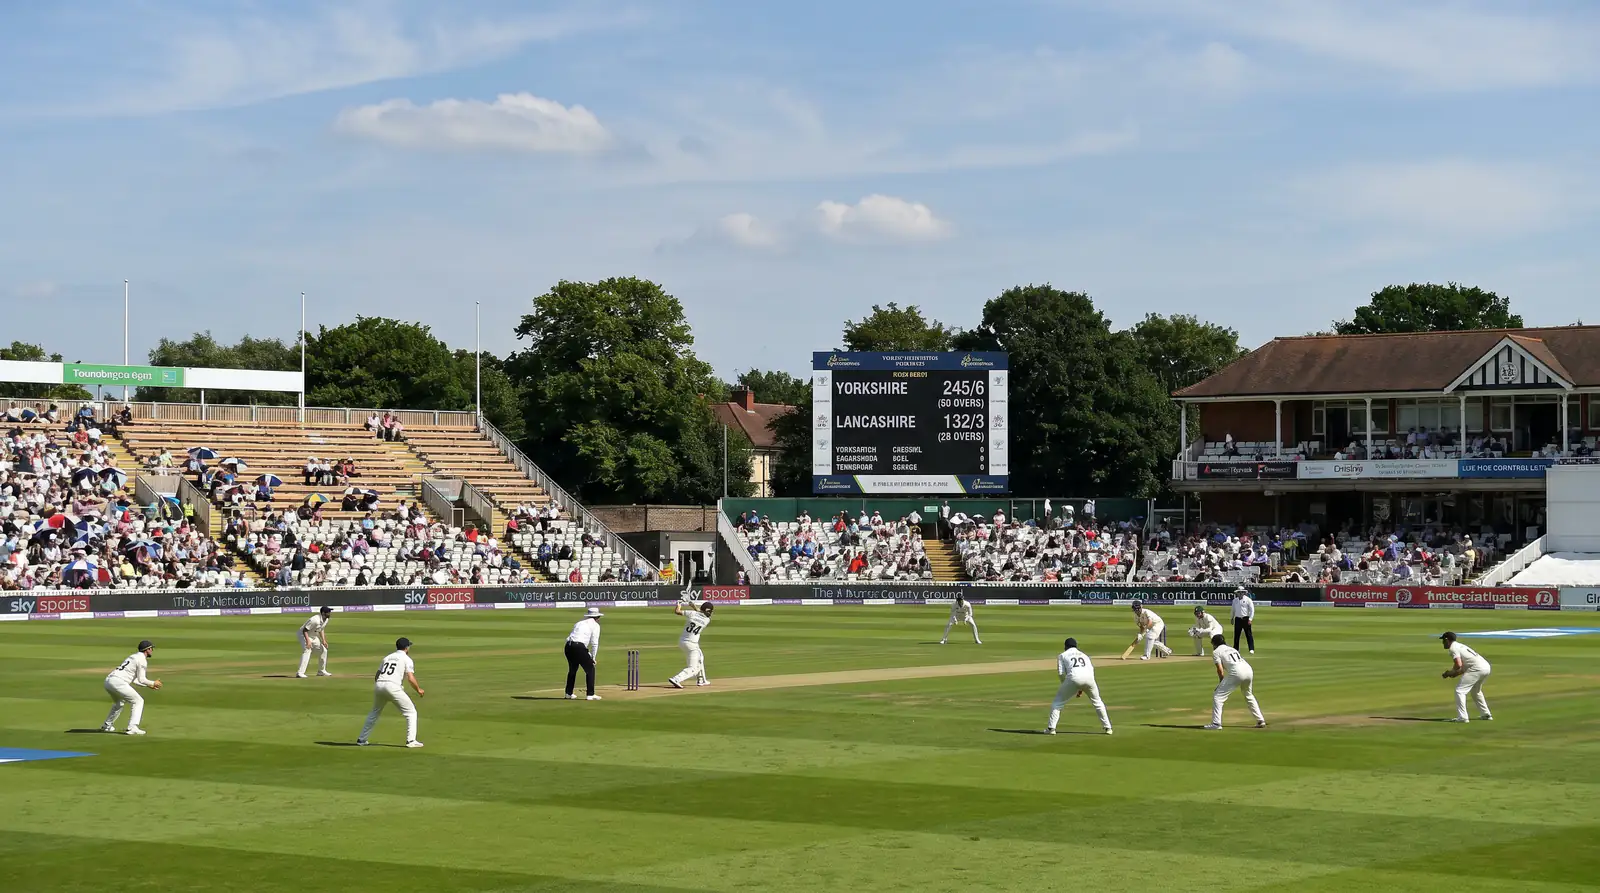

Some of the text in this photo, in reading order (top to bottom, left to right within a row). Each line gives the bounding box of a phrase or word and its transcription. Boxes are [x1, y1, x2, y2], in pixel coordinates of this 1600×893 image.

[836, 380, 985, 396] YORKSHIRE 245/6
[938, 398, 985, 408] (50 OVERS)
[836, 413, 985, 429] LANCASHIRE 132/3
[938, 432, 985, 442] (28 OVERS)
[404, 590, 471, 605] sky sports
[619, 589, 658, 601] Ground
[705, 588, 747, 600] sports
[812, 587, 833, 598] The
[881, 590, 919, 599] County
[922, 588, 964, 600] Ground
[11, 598, 87, 613] sky sports
[686, 622, 702, 635] 34
[1070, 657, 1086, 668] 29
